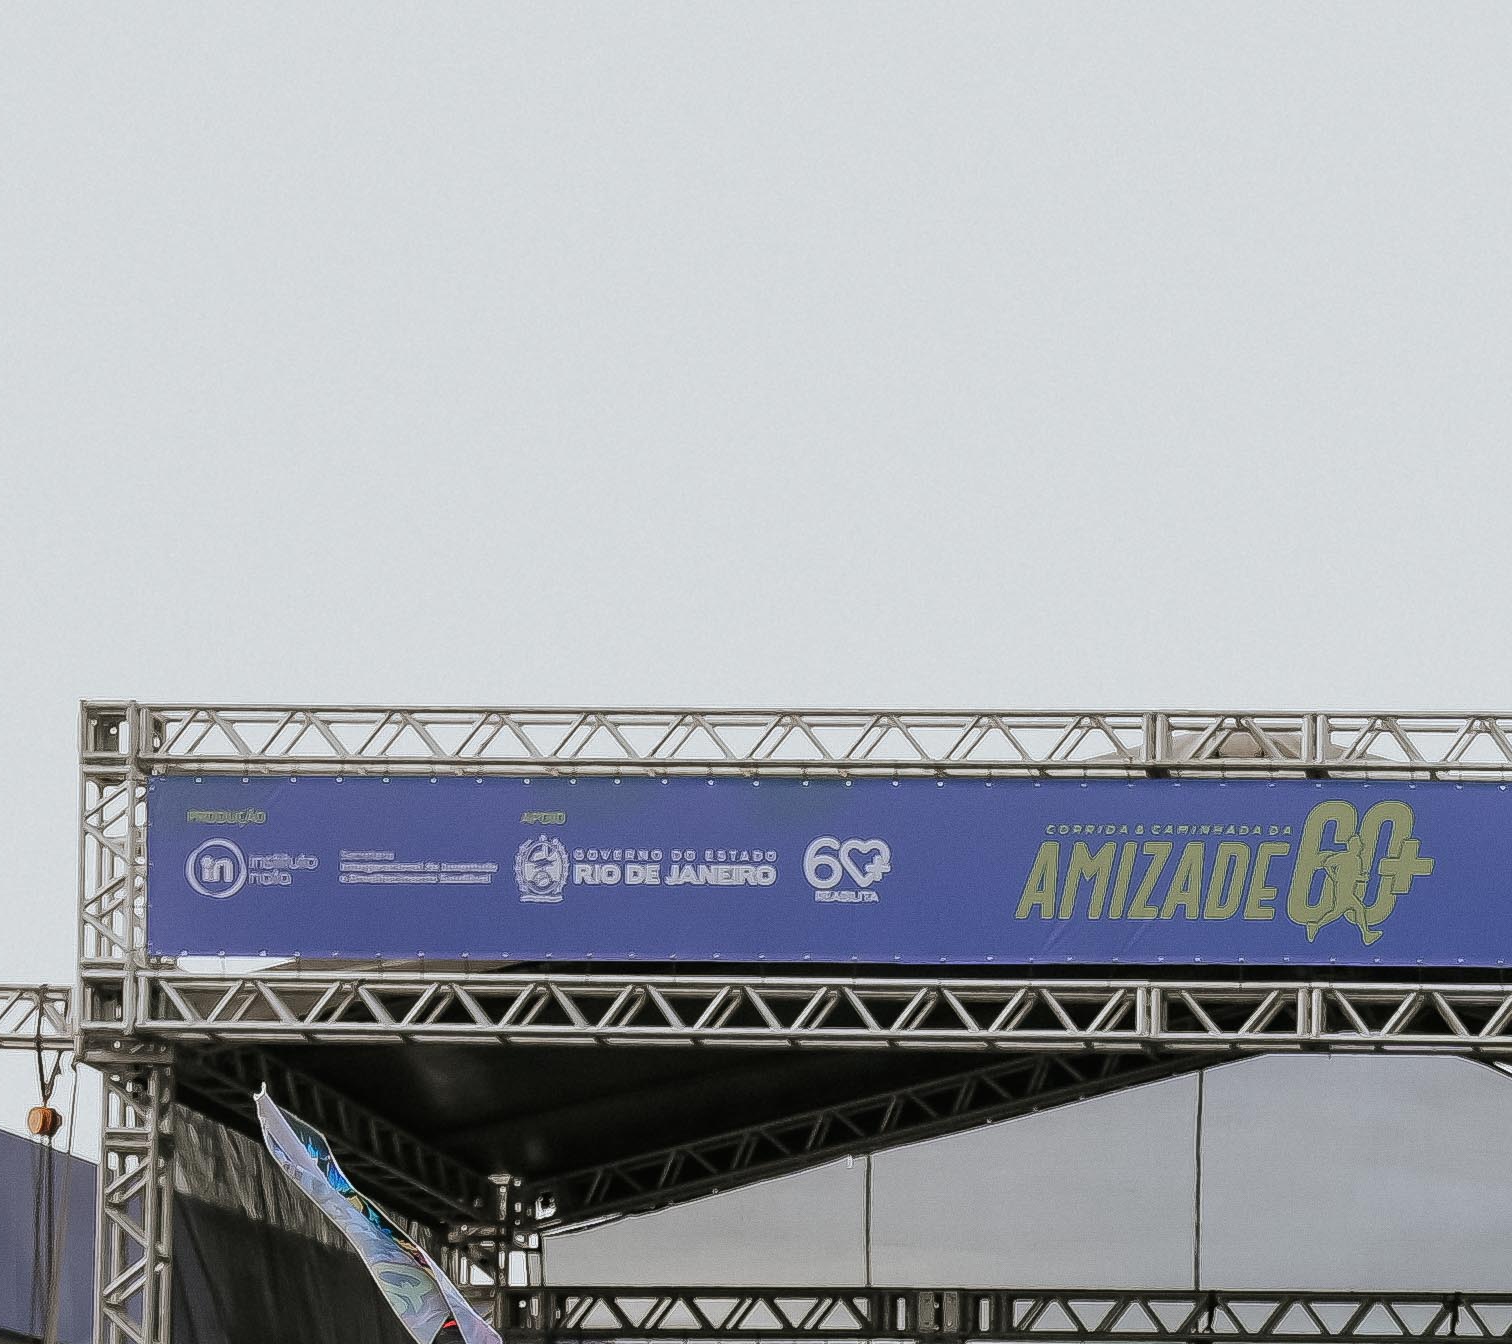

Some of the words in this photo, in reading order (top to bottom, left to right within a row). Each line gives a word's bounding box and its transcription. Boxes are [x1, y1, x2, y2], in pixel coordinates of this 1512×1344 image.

[573, 848, 663, 861] GOVERNO
[671, 849, 696, 861] DO
[704, 849, 777, 861] ESTADO
[574, 865, 622, 885] RIO
[624, 866, 660, 885] DE
[665, 866, 777, 886] JANEIRO
[1013, 841, 1290, 920] AMIZADE
[1287, 800, 1436, 935] 60+
